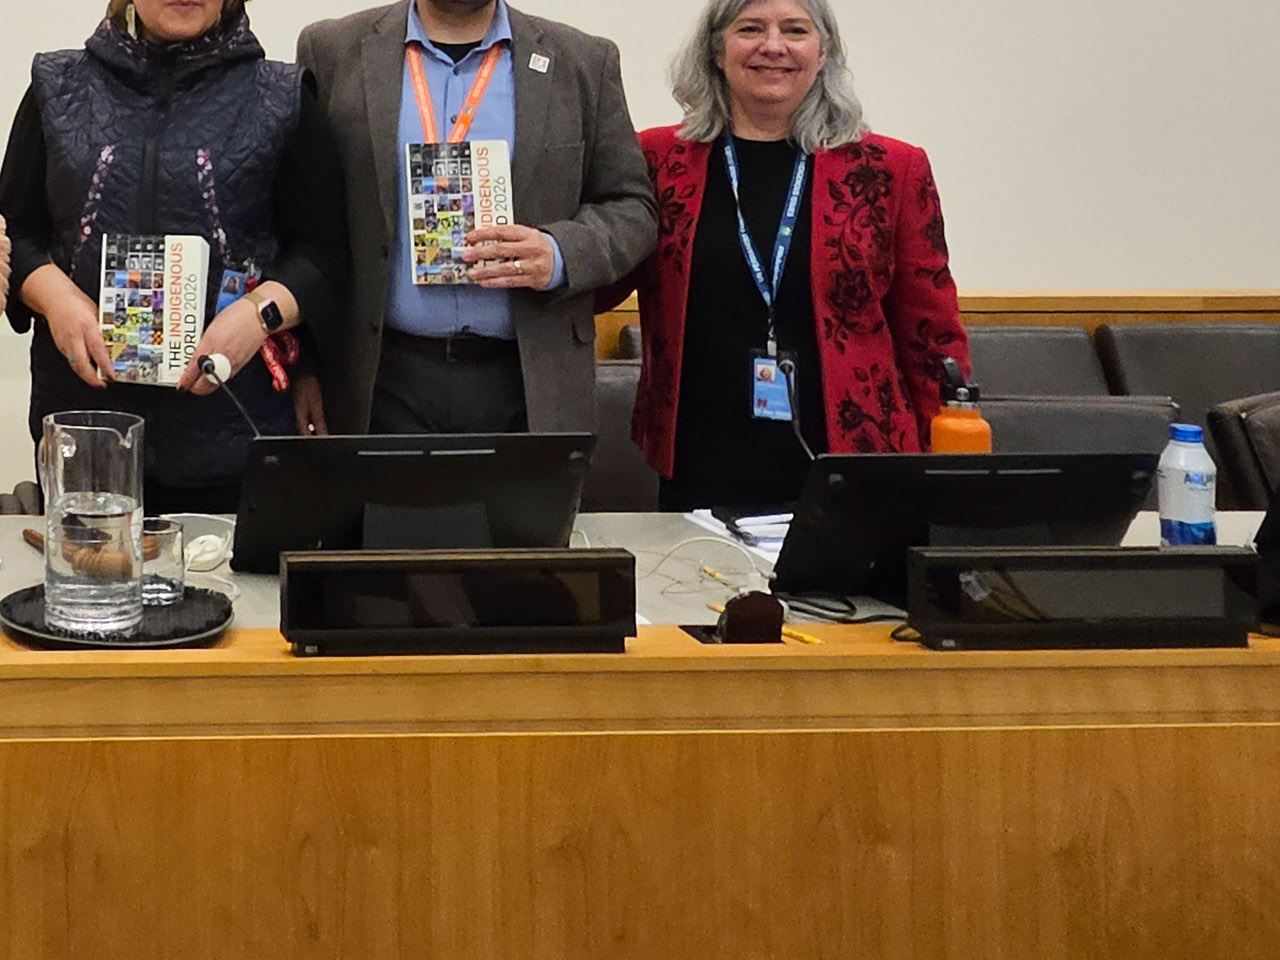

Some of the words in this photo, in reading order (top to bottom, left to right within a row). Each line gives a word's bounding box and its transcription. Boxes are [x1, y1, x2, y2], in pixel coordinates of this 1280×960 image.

[476, 147, 493, 227] DIGENOUS
[494, 176, 508, 211] 2026
[170, 242, 184, 338] INDIGENOUS
[184, 273, 198, 310] 2026
[169, 341, 182, 370] THE
